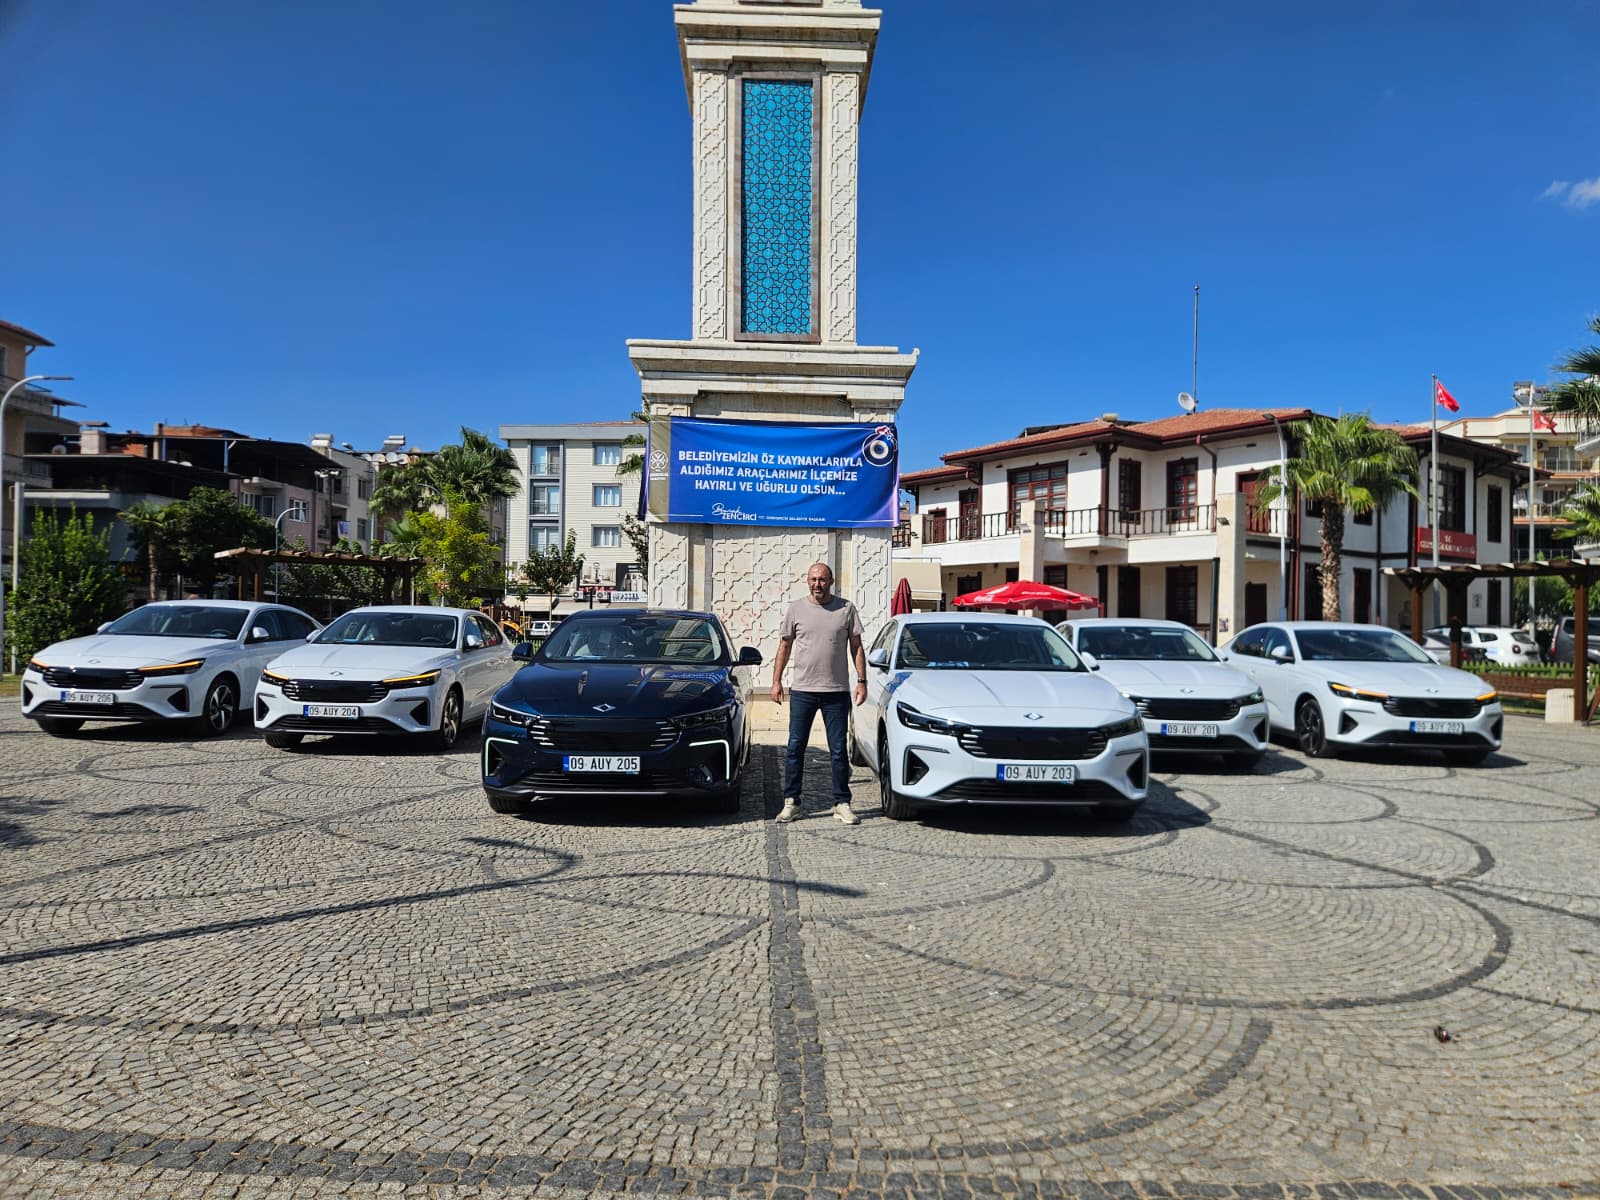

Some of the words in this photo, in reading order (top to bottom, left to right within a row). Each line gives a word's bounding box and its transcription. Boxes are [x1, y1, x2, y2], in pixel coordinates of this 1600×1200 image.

[678, 449, 758, 464] BELEDİYEMİZİN
[761, 452, 774, 465] ÖZ
[777, 455, 863, 467] KAYNAKLARIYLA
[680, 463, 735, 476] ALDIĞIMIZ
[737, 467, 807, 480] ARAÇLARIMIZ
[810, 469, 858, 482] İLÇEMİZE
[695, 479, 736, 491] HAYIRLI
[739, 481, 753, 492] VE
[756, 480, 798, 493] UĞURLU
[801, 484, 846, 495] OLSUN...
[310, 706, 320, 716] 09
[323, 707, 339, 716] AUY
[342, 707, 357, 717] 204
[1167, 724, 1178, 734] 09
[1181, 724, 1197, 734] AUY
[570, 757, 585, 770] 09
[590, 757, 612, 770] AUY
[617, 757, 638, 770] 205
[1006, 766, 1020, 779] 09
[1025, 766, 1047, 779] AUY
[1052, 767, 1073, 780] 203
